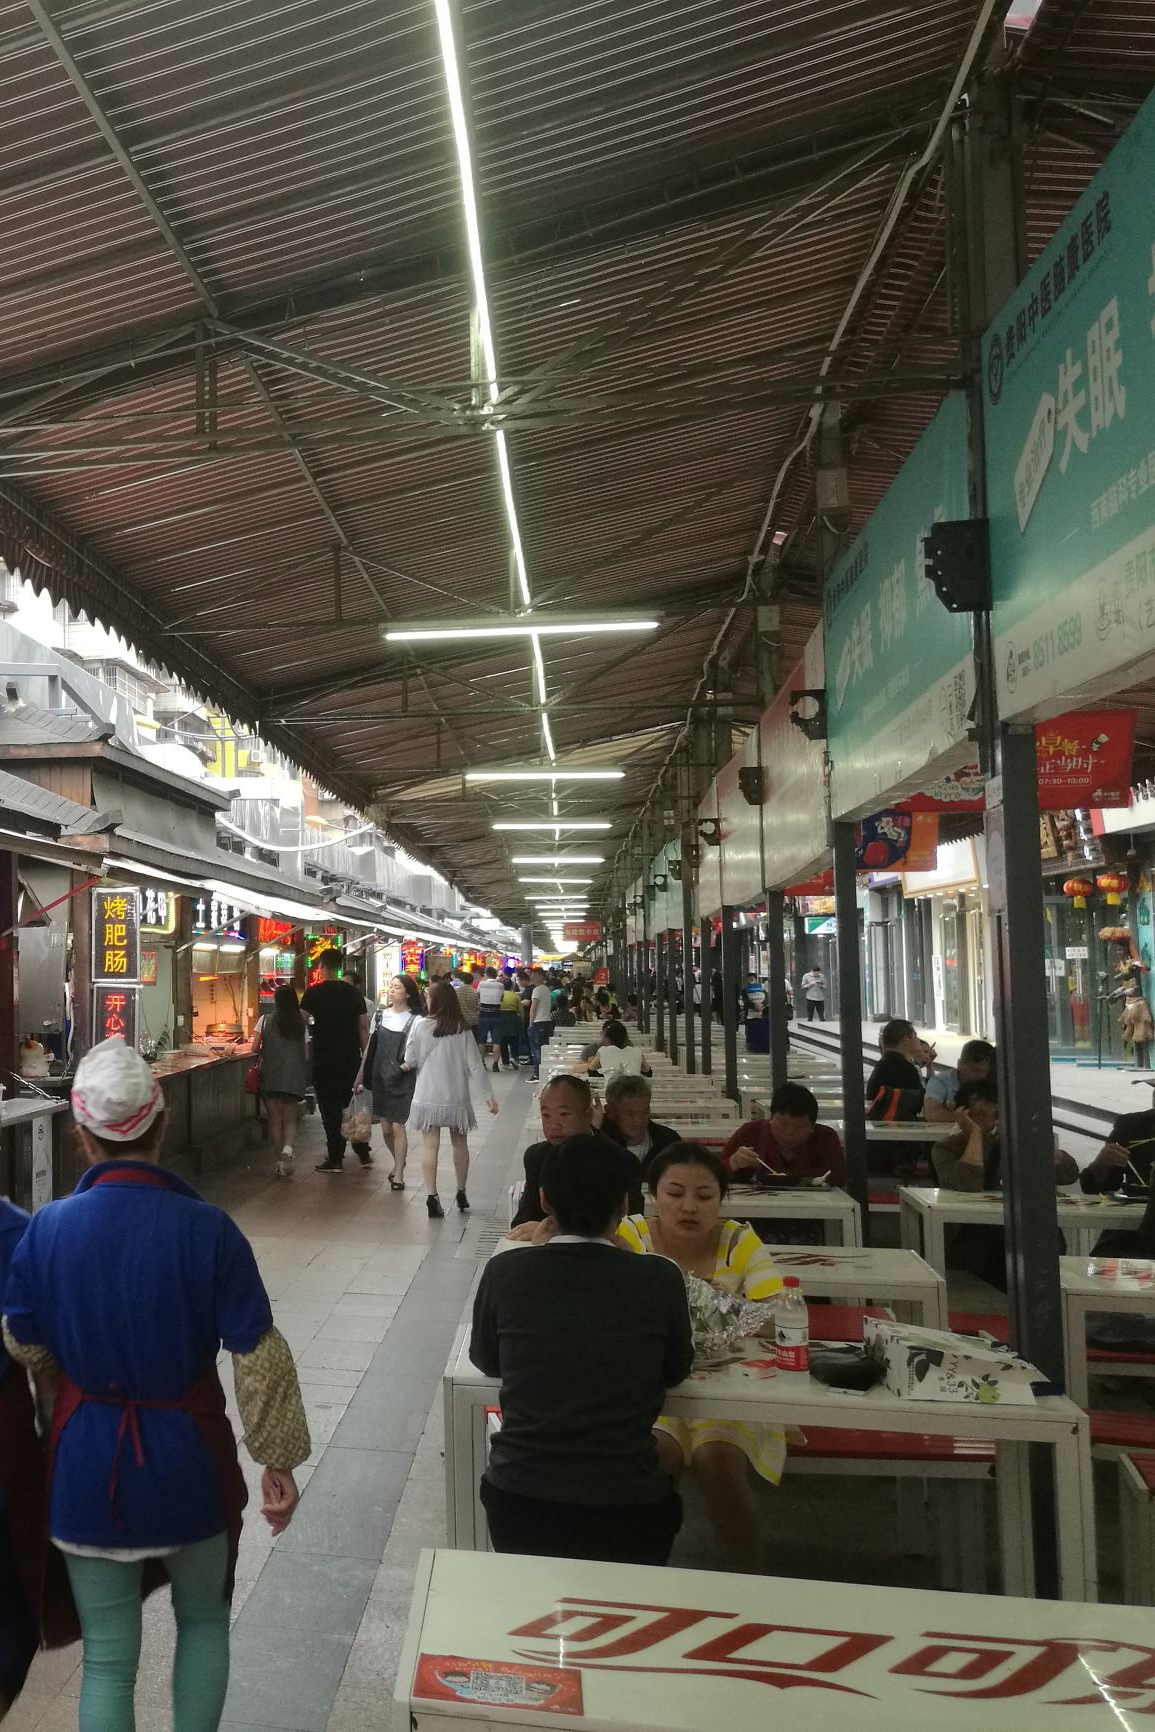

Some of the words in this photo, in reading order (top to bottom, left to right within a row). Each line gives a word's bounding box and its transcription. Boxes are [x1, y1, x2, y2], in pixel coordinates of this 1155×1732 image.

[1057, 295, 1126, 475] 失眠
[1036, 735, 1080, 756] 早餐
[139, 887, 167, 926] 花甲
[103, 895, 128, 974] 烤肥肠
[105, 993, 126, 1044] 开心
